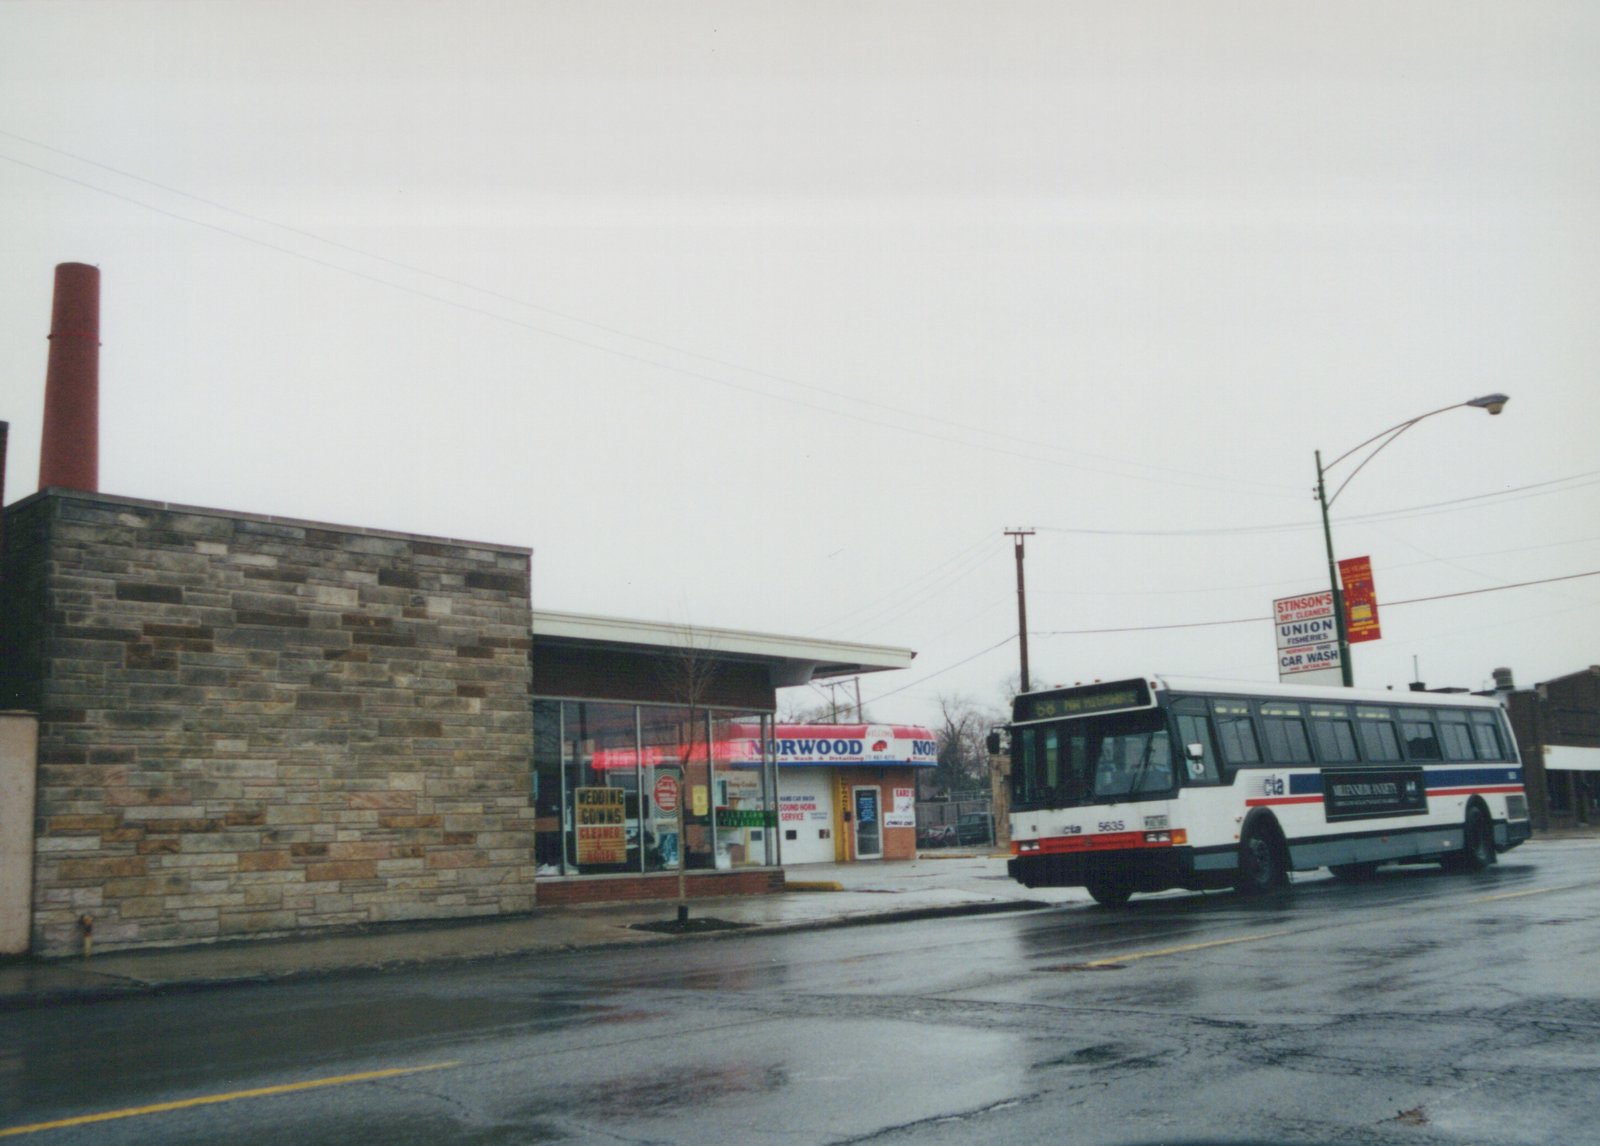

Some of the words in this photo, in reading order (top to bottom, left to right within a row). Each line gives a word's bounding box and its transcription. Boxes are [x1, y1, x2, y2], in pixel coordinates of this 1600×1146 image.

[1277, 593, 1332, 613] STINSON'S
[1296, 607, 1331, 619] CLEANERS
[1281, 619, 1333, 637] UNION
[1287, 633, 1329, 645] FISHERIES
[1281, 655, 1303, 667] CAR
[1307, 650, 1338, 664] WASH
[749, 739, 863, 756] NORWOOD
[1263, 773, 1285, 796] cta
[578, 789, 625, 805] WEDDING
[582, 807, 622, 825] GOWNS
[1063, 824, 1082, 834] cta
[1098, 820, 1125, 832] 5635
